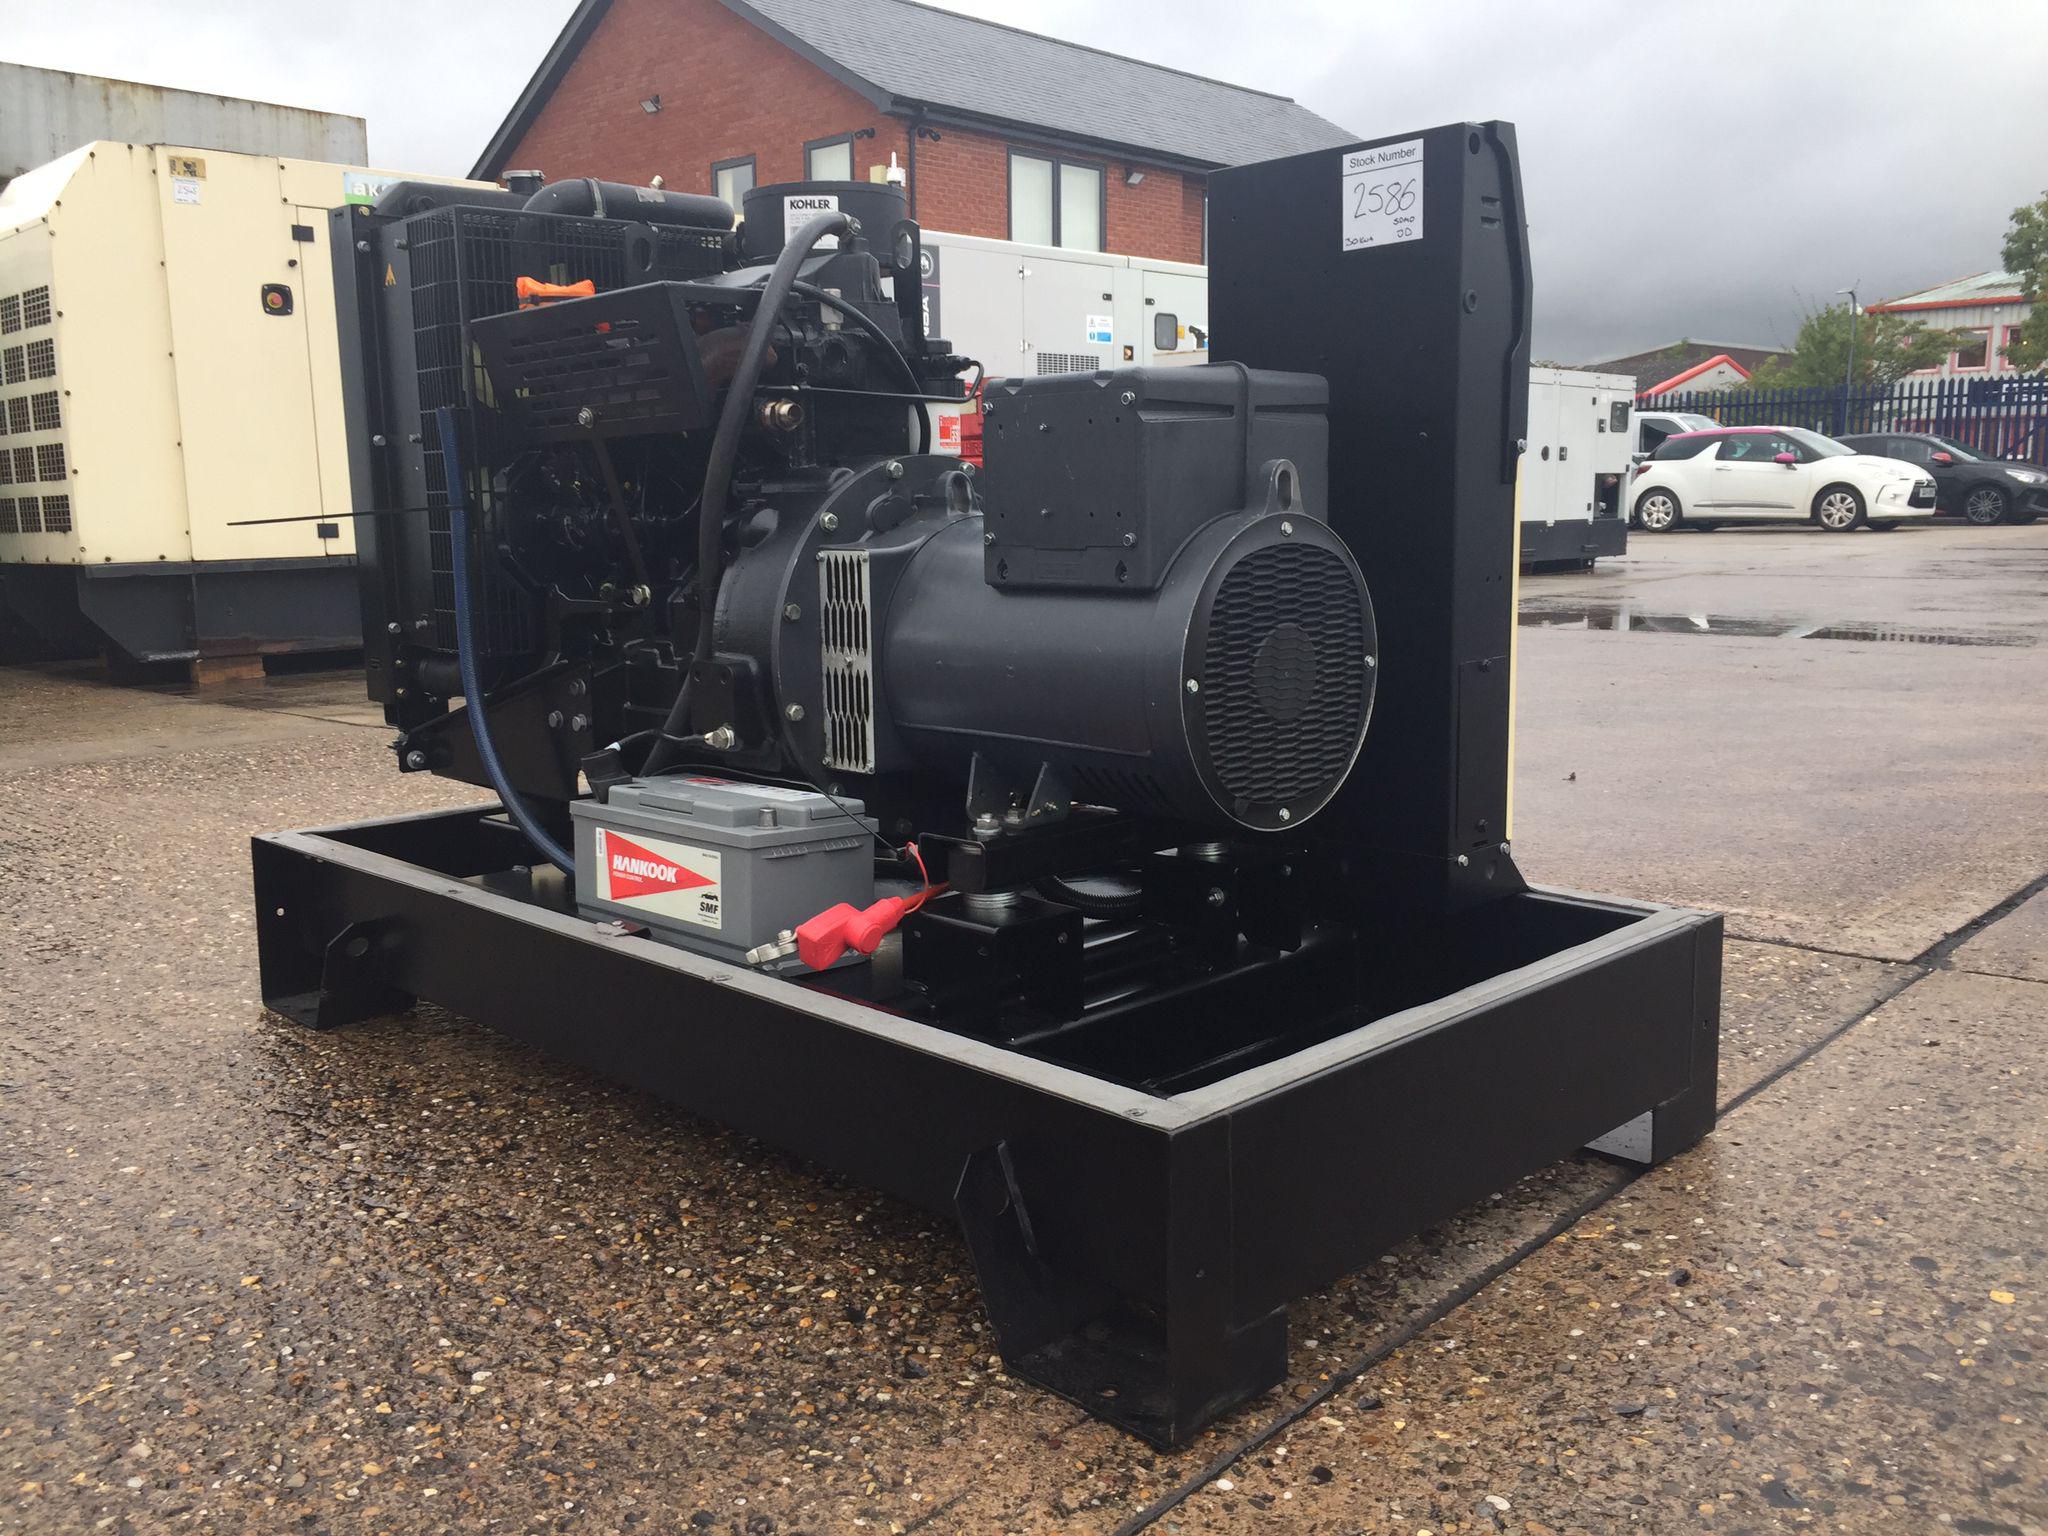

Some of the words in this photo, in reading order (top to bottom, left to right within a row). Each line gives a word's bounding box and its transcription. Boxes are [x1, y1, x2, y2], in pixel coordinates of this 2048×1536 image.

[1349, 155, 1376, 169] Stock
[1378, 147, 1416, 163] Number
[790, 199, 831, 210] KOHLER
[1354, 178, 1416, 219] 2586
[613, 854, 679, 884] HANKOOK
[699, 901, 719, 915] SMF
